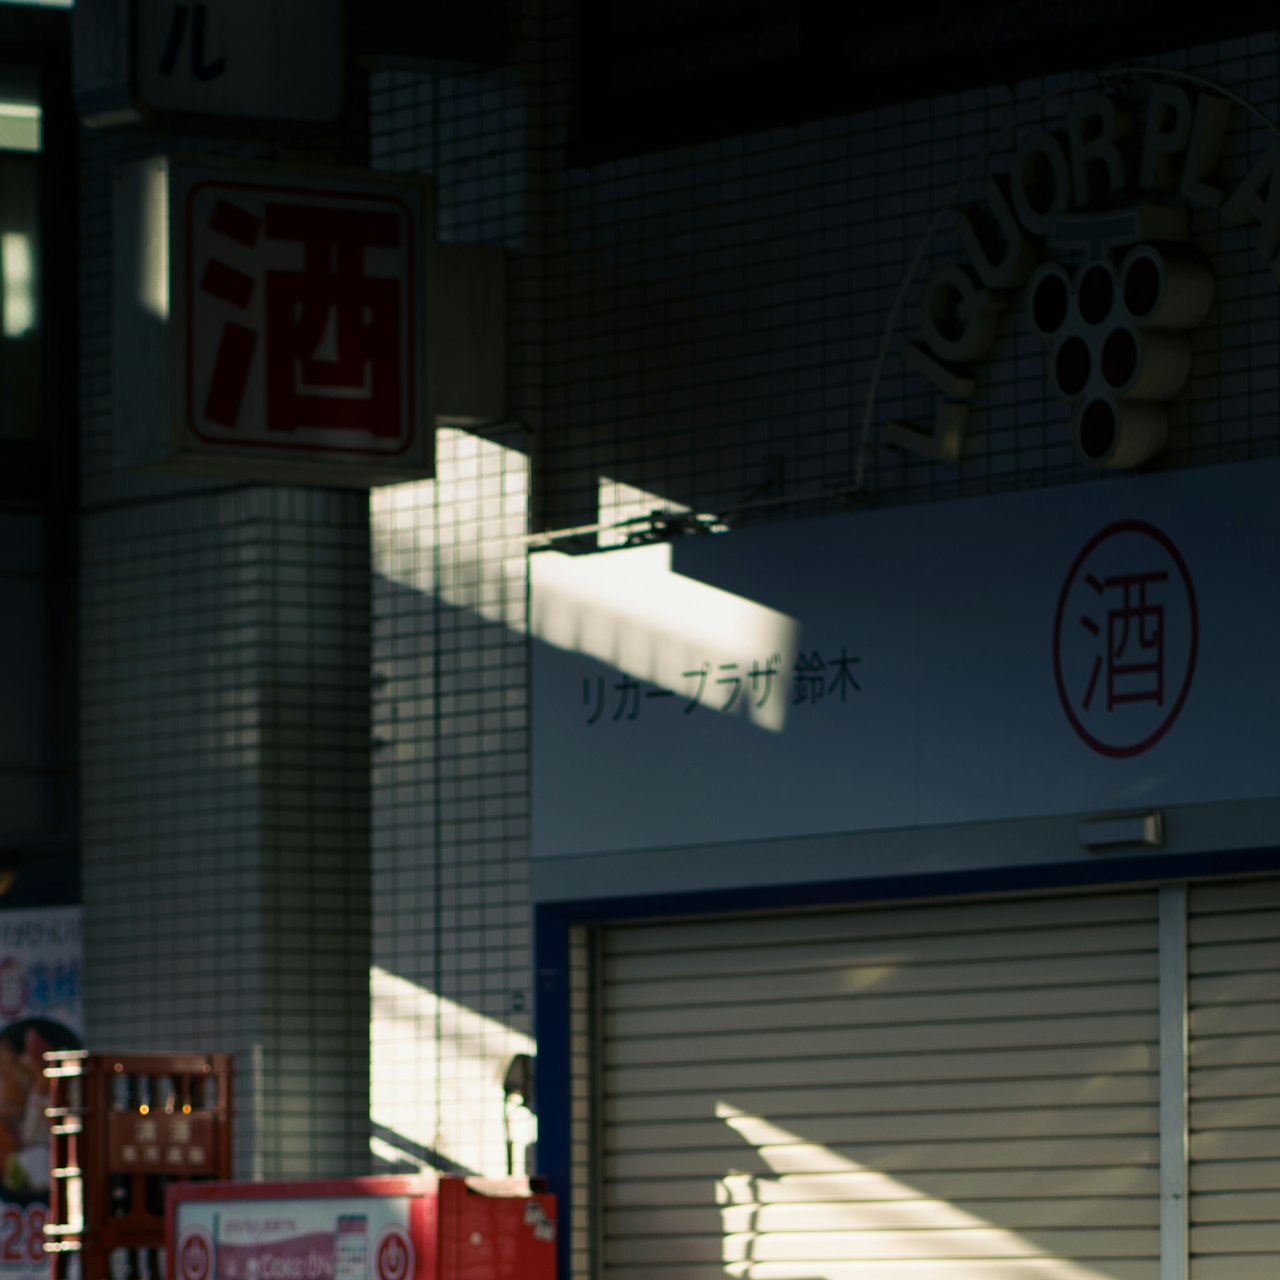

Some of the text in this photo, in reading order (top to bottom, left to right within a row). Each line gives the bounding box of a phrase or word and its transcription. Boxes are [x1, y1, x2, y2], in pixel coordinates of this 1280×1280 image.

[204, 201, 400, 437] 酒
[882, 92, 1130, 463] LIQUOR
[582, 647, 861, 725] リカープラザ 鈴木
[1081, 570, 1168, 712] 酒
